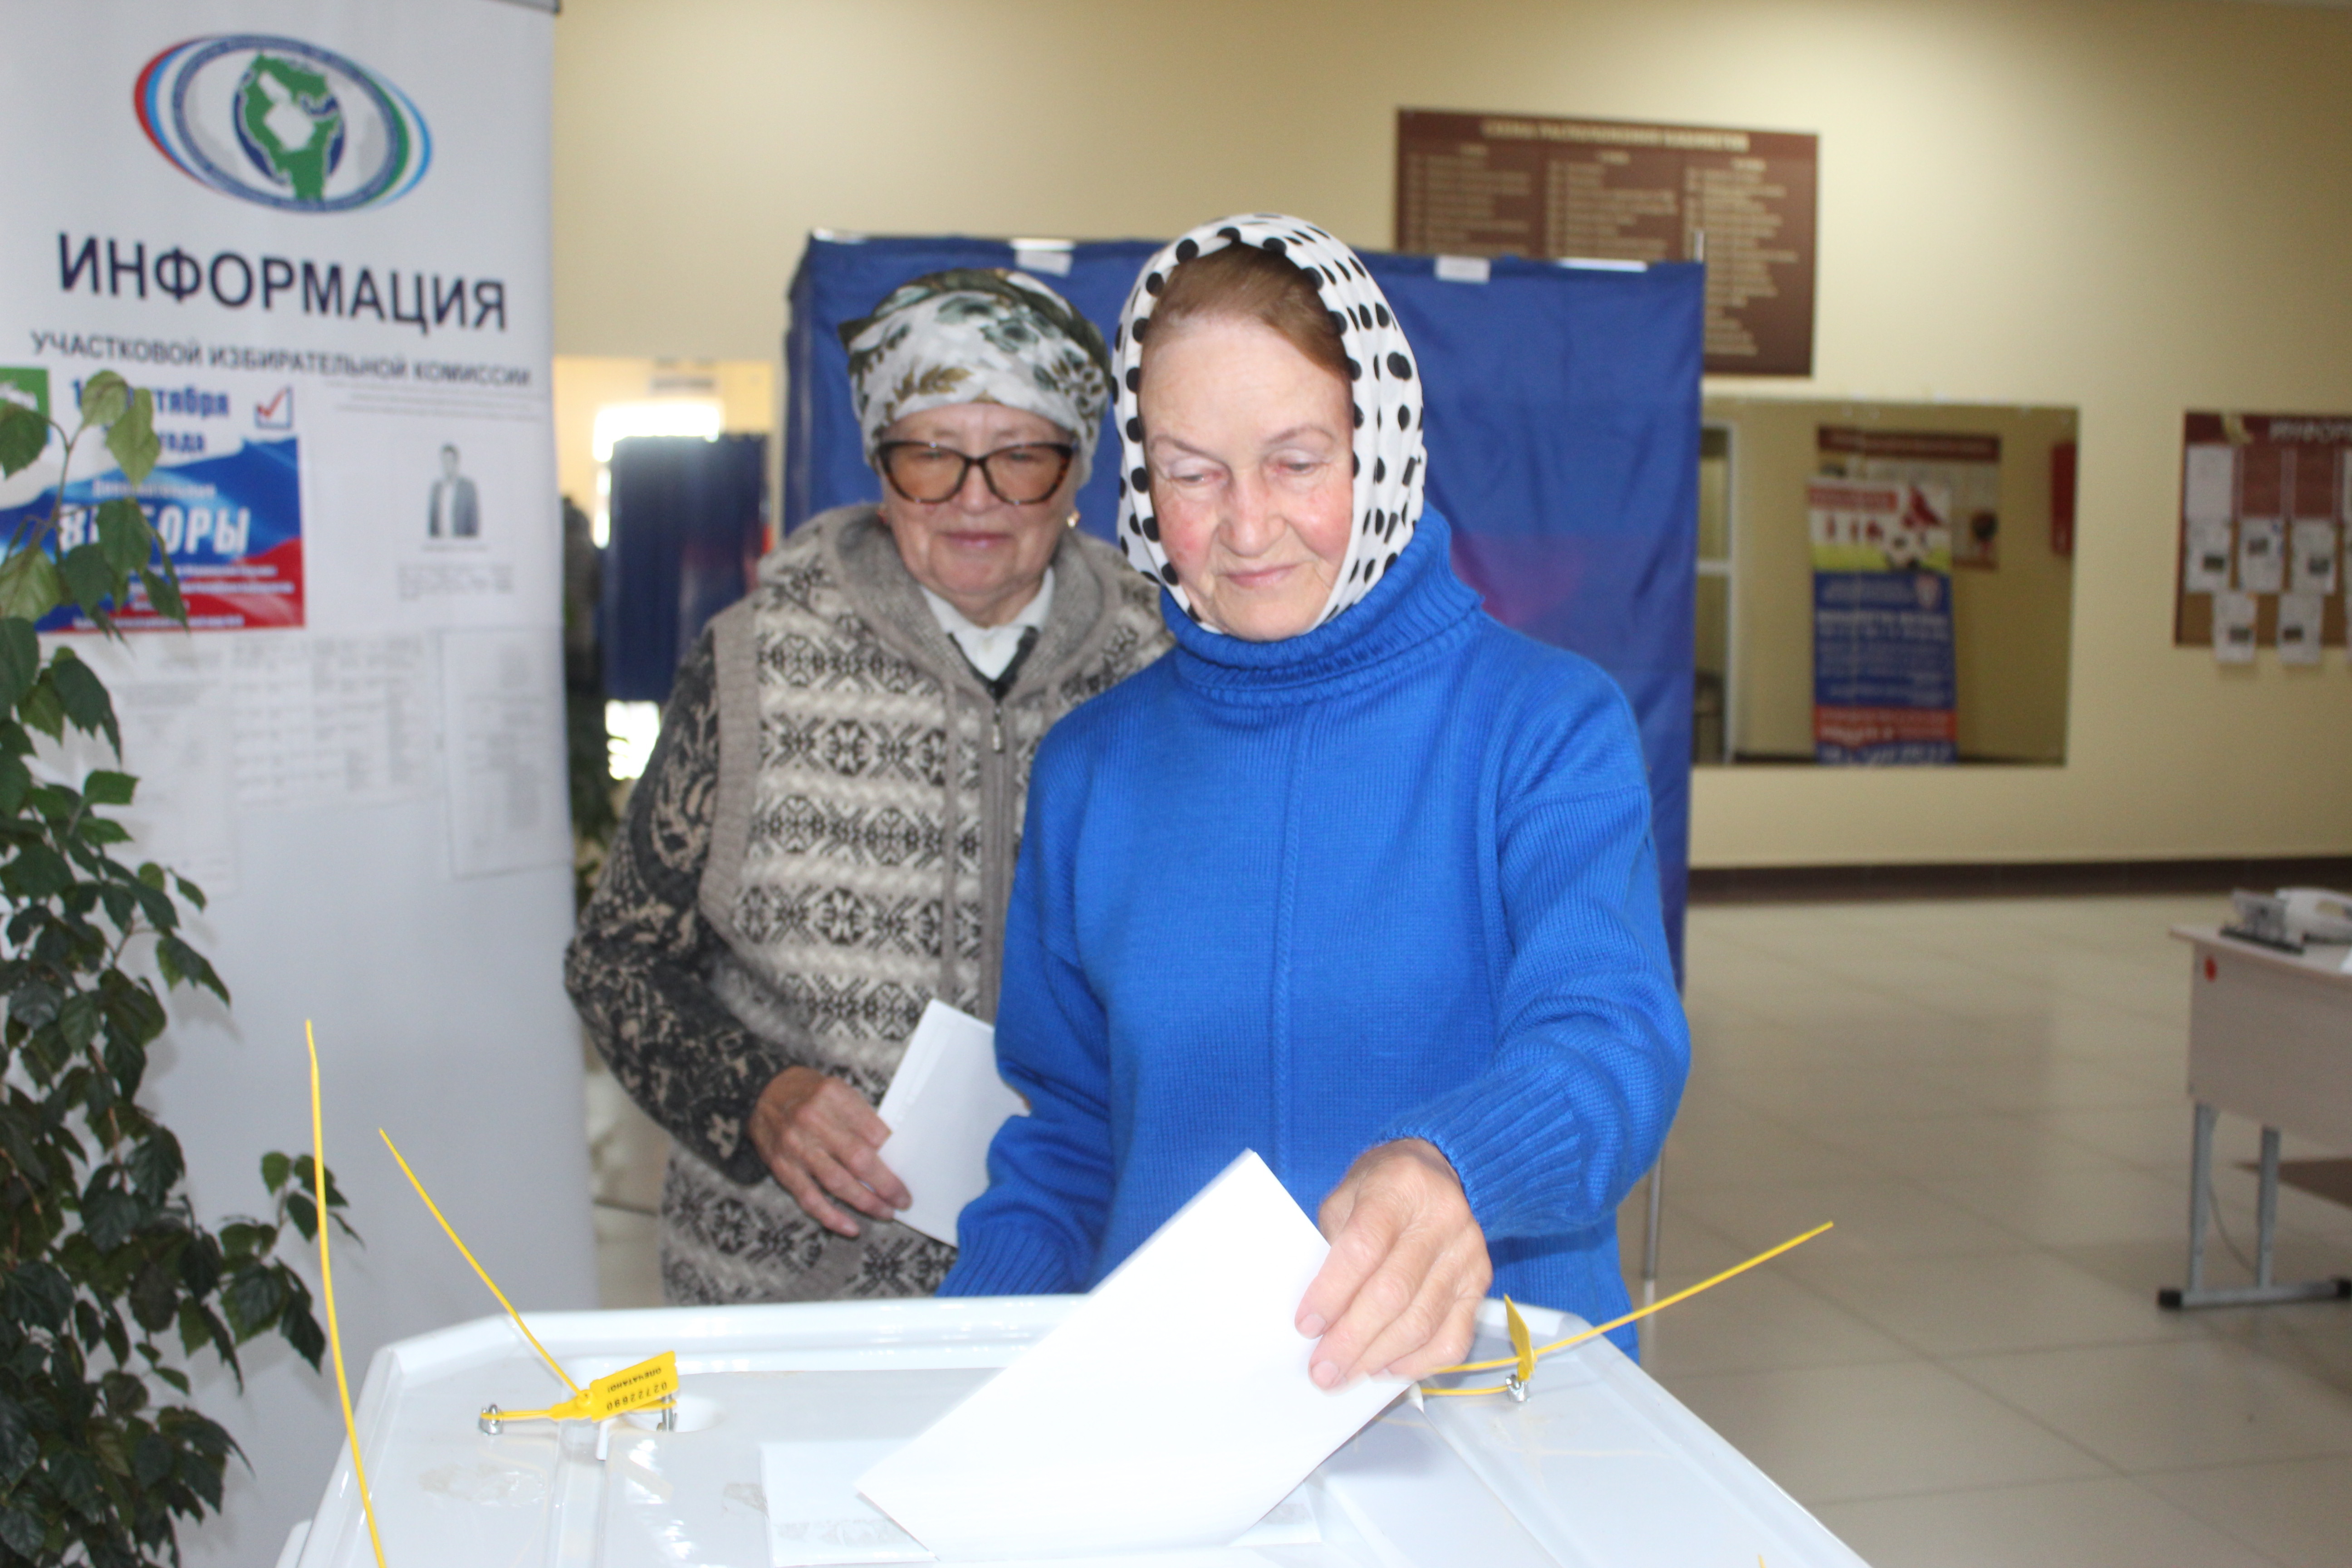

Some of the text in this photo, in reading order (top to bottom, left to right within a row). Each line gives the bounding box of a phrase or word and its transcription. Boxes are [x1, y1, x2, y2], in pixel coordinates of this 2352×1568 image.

[59, 232, 507, 335] ИНФОРМАЦИЯ
[30, 330, 531, 386] УЧАСТКОВОЙ ИЗБИРАТЕЛЬНОЙ КОМИССИИ
